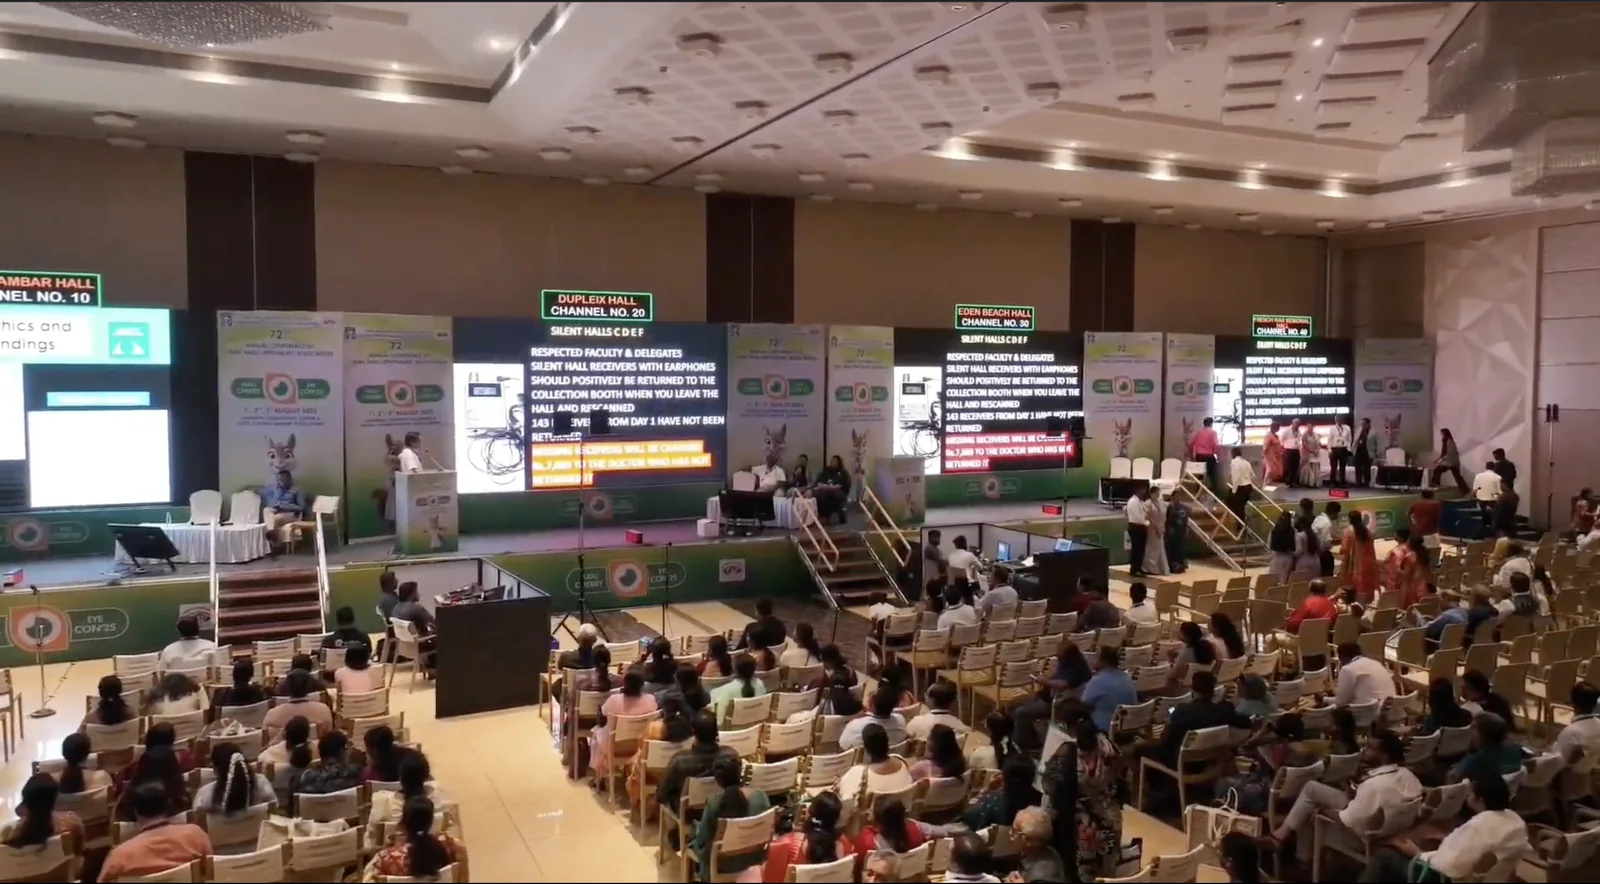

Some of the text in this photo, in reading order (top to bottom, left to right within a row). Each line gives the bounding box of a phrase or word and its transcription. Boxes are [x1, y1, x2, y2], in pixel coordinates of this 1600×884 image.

[0, 276, 95, 288] AMBAR HALL
[36, 291, 66, 302] NO.
[70, 292, 90, 304] 10
[558, 294, 637, 305] DUPLEIX HALL
[550, 306, 645, 317] CHANNEL NO. 20
[958, 308, 1032, 318] EDEN BEACH HALL
[40, 321, 72, 332] and
[962, 318, 1029, 327] CHANNEL NO. 30
[550, 326, 644, 336] SILENT HALLS C D E F
[1288, 328, 1299, 336] NO.
[1300, 328, 1308, 336] 40
[961, 335, 1028, 344] SILENT HALLS C D E F
[530, 348, 682, 358] RESPECTED FACULTY & DELEGATES
[947, 353, 984, 361] RESPECTED
[1021, 354, 1055, 362] DELEGATES
[531, 362, 716, 371] SILENT HALL RECEIVERS WITH EARPHONES
[946, 365, 969, 373] SILENT
[970, 365, 987, 373] HALL
[988, 365, 1022, 373] RECEIVERS
[1023, 365, 1040, 373] WITH
[531, 376, 715, 385] SHOULD POSITIVELY BE RETURNED TO THE
[946, 377, 1078, 385] SHOULD POSITIVELY BE RETURNED TO THE
[532, 389, 718, 399] COLLECTION BOOTH WHEN YOU LEAVE THE
[946, 388, 1080, 397] COLLECTION BOOTH WHEN YOU LEAVE THE
[532, 404, 555, 414] HALL
[557, 404, 578, 413] AND
[996, 412, 1015, 420] FROM
[532, 418, 548, 427] 143
[631, 417, 648, 426] DAY
[650, 417, 655, 426] 1
[658, 417, 681, 426] HAVE
[683, 416, 701, 425] NOT
[703, 416, 724, 425] BEEN
[87, 615, 103, 623] EYE
